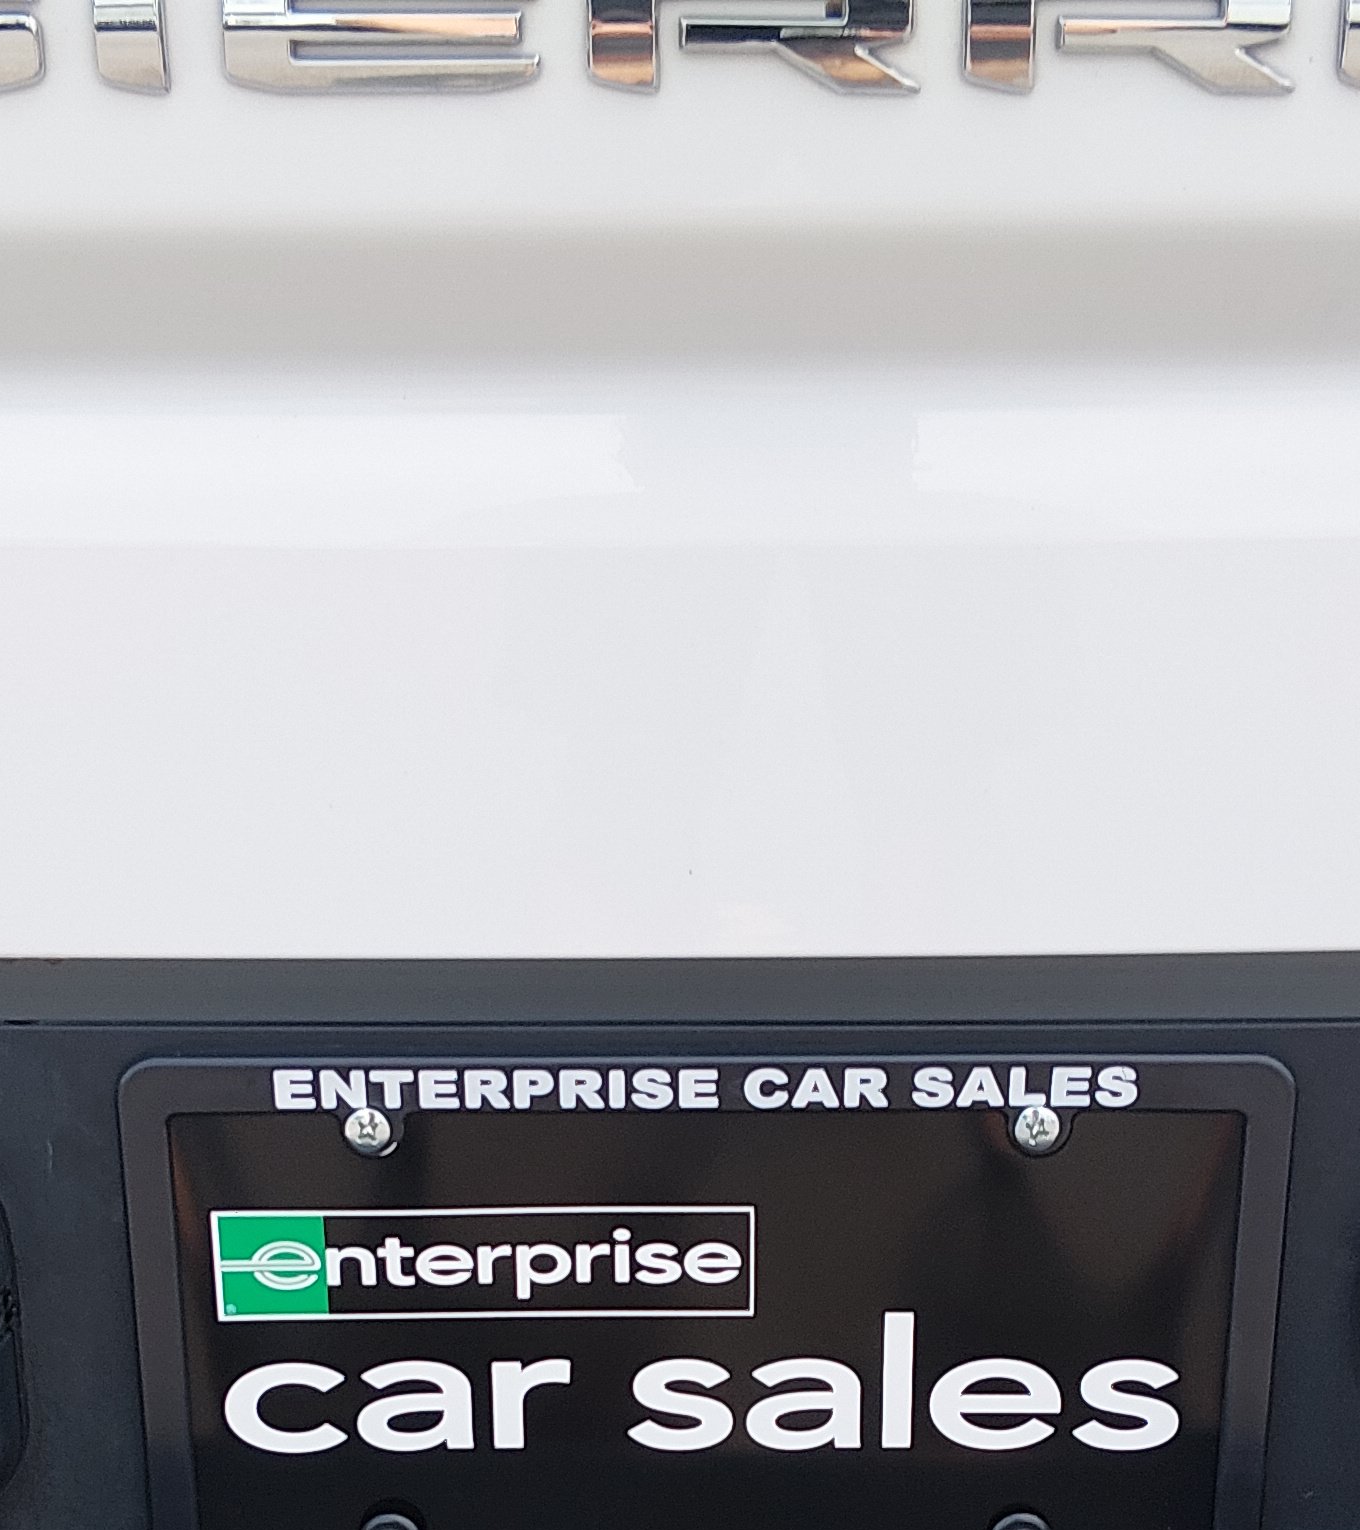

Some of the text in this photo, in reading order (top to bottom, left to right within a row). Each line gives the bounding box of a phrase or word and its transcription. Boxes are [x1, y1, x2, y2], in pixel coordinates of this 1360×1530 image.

[272, 1066, 1139, 1111] ENTERPRISE CAR SALES
[248, 1227, 743, 1300] enterprise
[223, 1311, 1181, 1454] car sales
